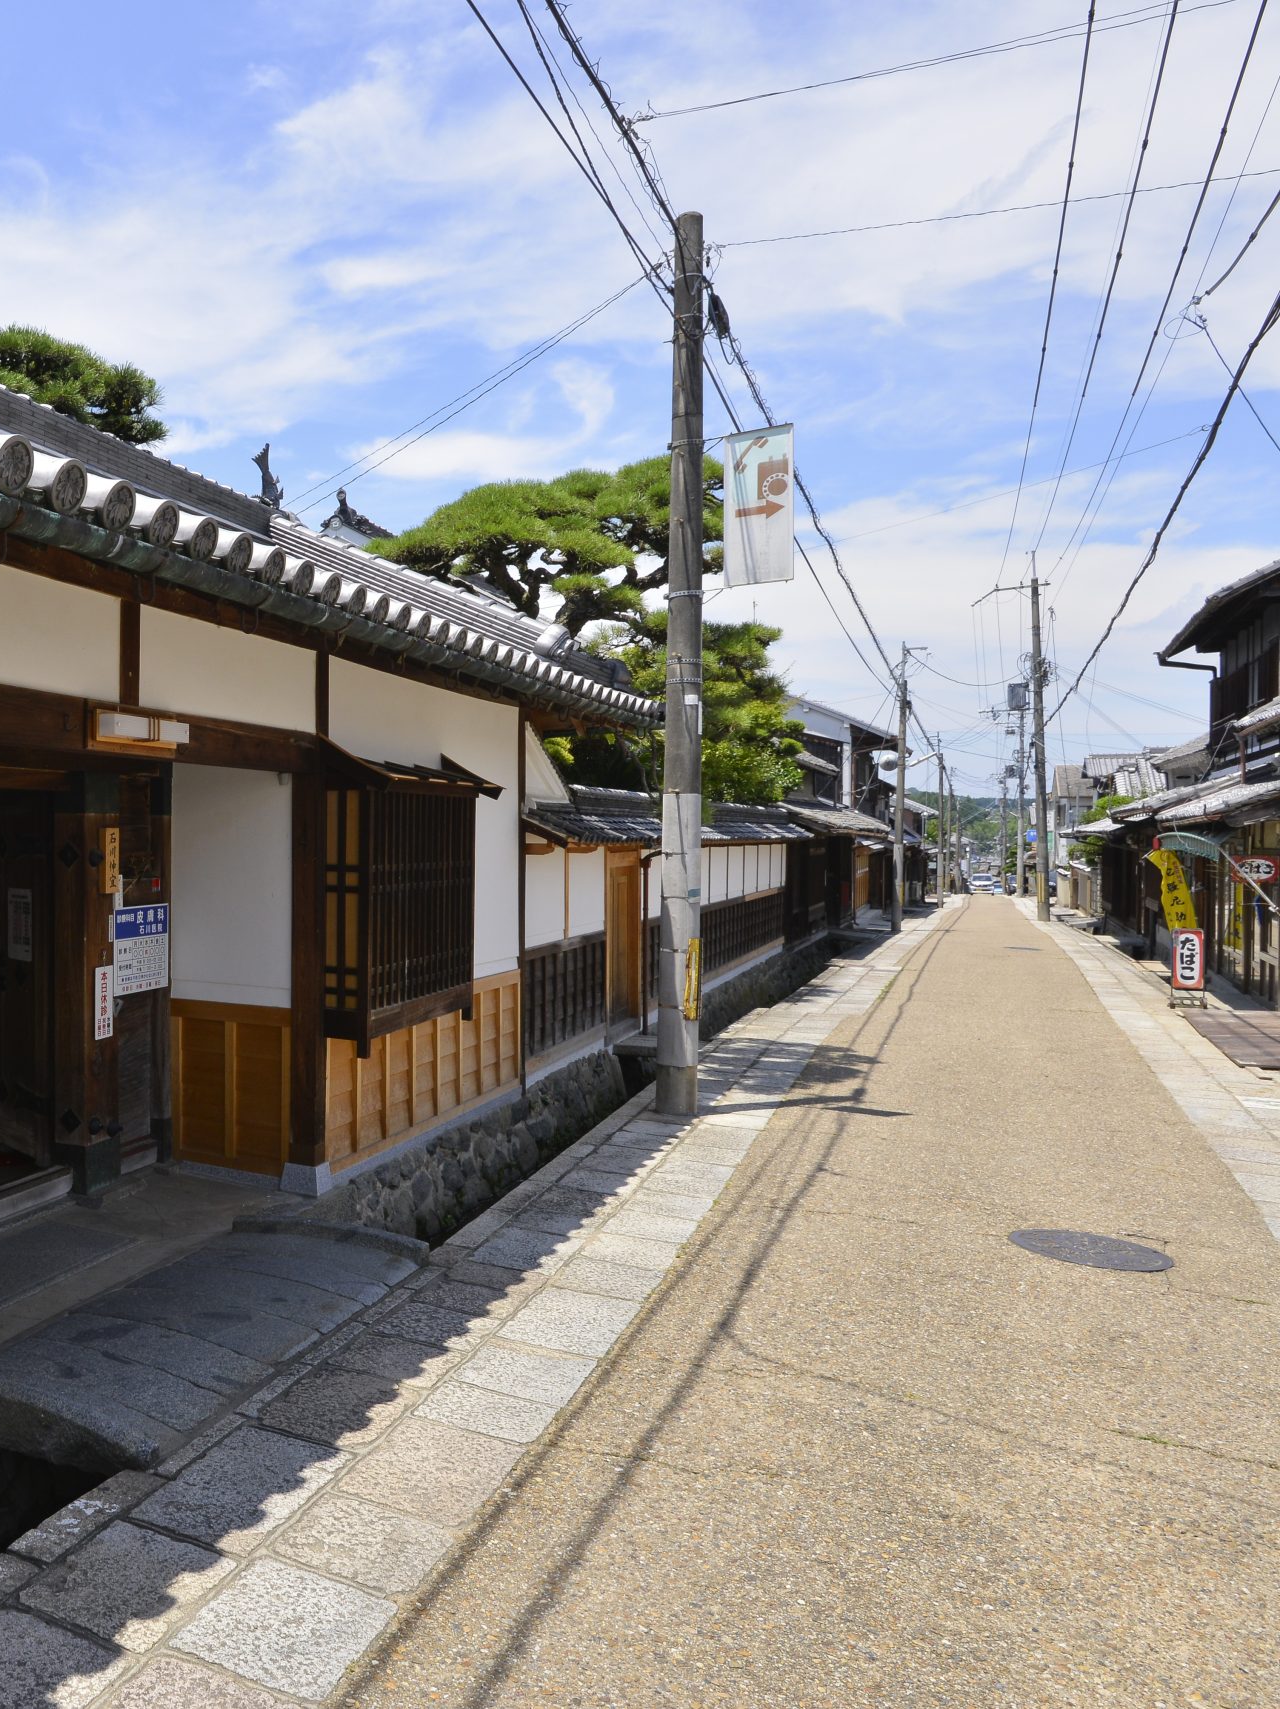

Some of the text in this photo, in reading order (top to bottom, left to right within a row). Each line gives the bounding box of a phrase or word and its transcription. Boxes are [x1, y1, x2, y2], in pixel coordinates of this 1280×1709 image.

[136, 908, 164, 924] 皮膚科
[139, 923, 163, 934] 石川医院
[1180, 936, 1198, 980] たばこ
[100, 971, 108, 1017] 本日休診
